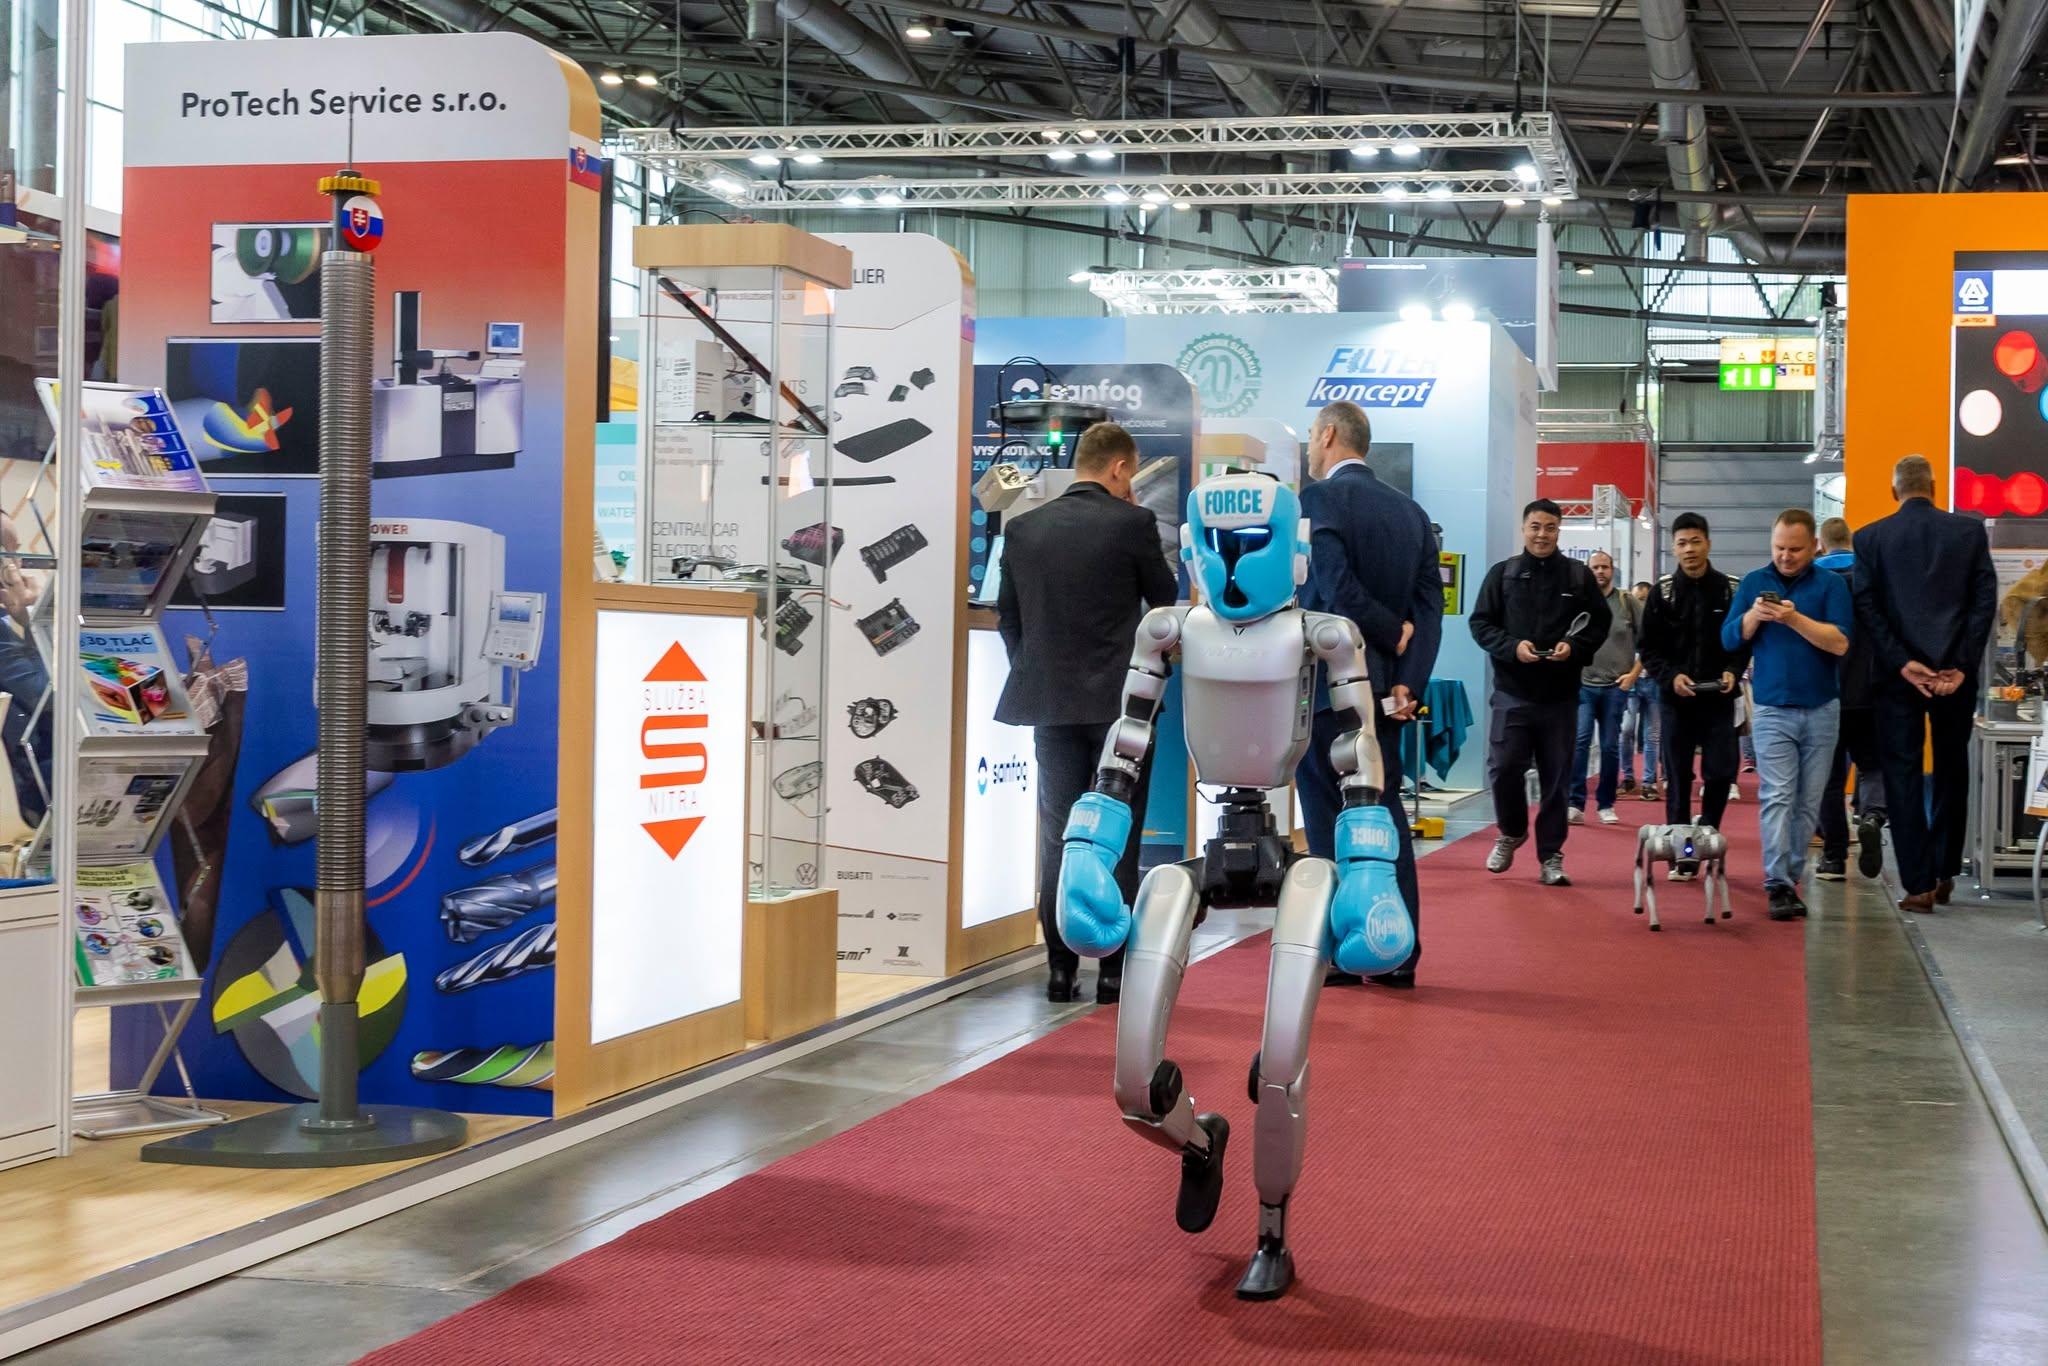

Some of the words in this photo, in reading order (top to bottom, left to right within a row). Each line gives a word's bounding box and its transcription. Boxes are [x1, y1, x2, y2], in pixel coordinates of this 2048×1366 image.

[182, 88, 299, 118] ProTech
[309, 86, 422, 116] Service
[431, 91, 507, 113] s.r.o.
[853, 268, 885, 284] LIER
[1050, 378, 1142, 410] sanfog
[1311, 378, 1432, 407] koncept
[1205, 489, 1262, 515] FORCE
[370, 524, 408, 535] OWER
[713, 522, 739, 538] CAR
[110, 634, 153, 646] TLAČ
[993, 754, 1028, 792] sanfog
[648, 790, 698, 817] NITRA
[837, 869, 873, 881] BUGATTI
